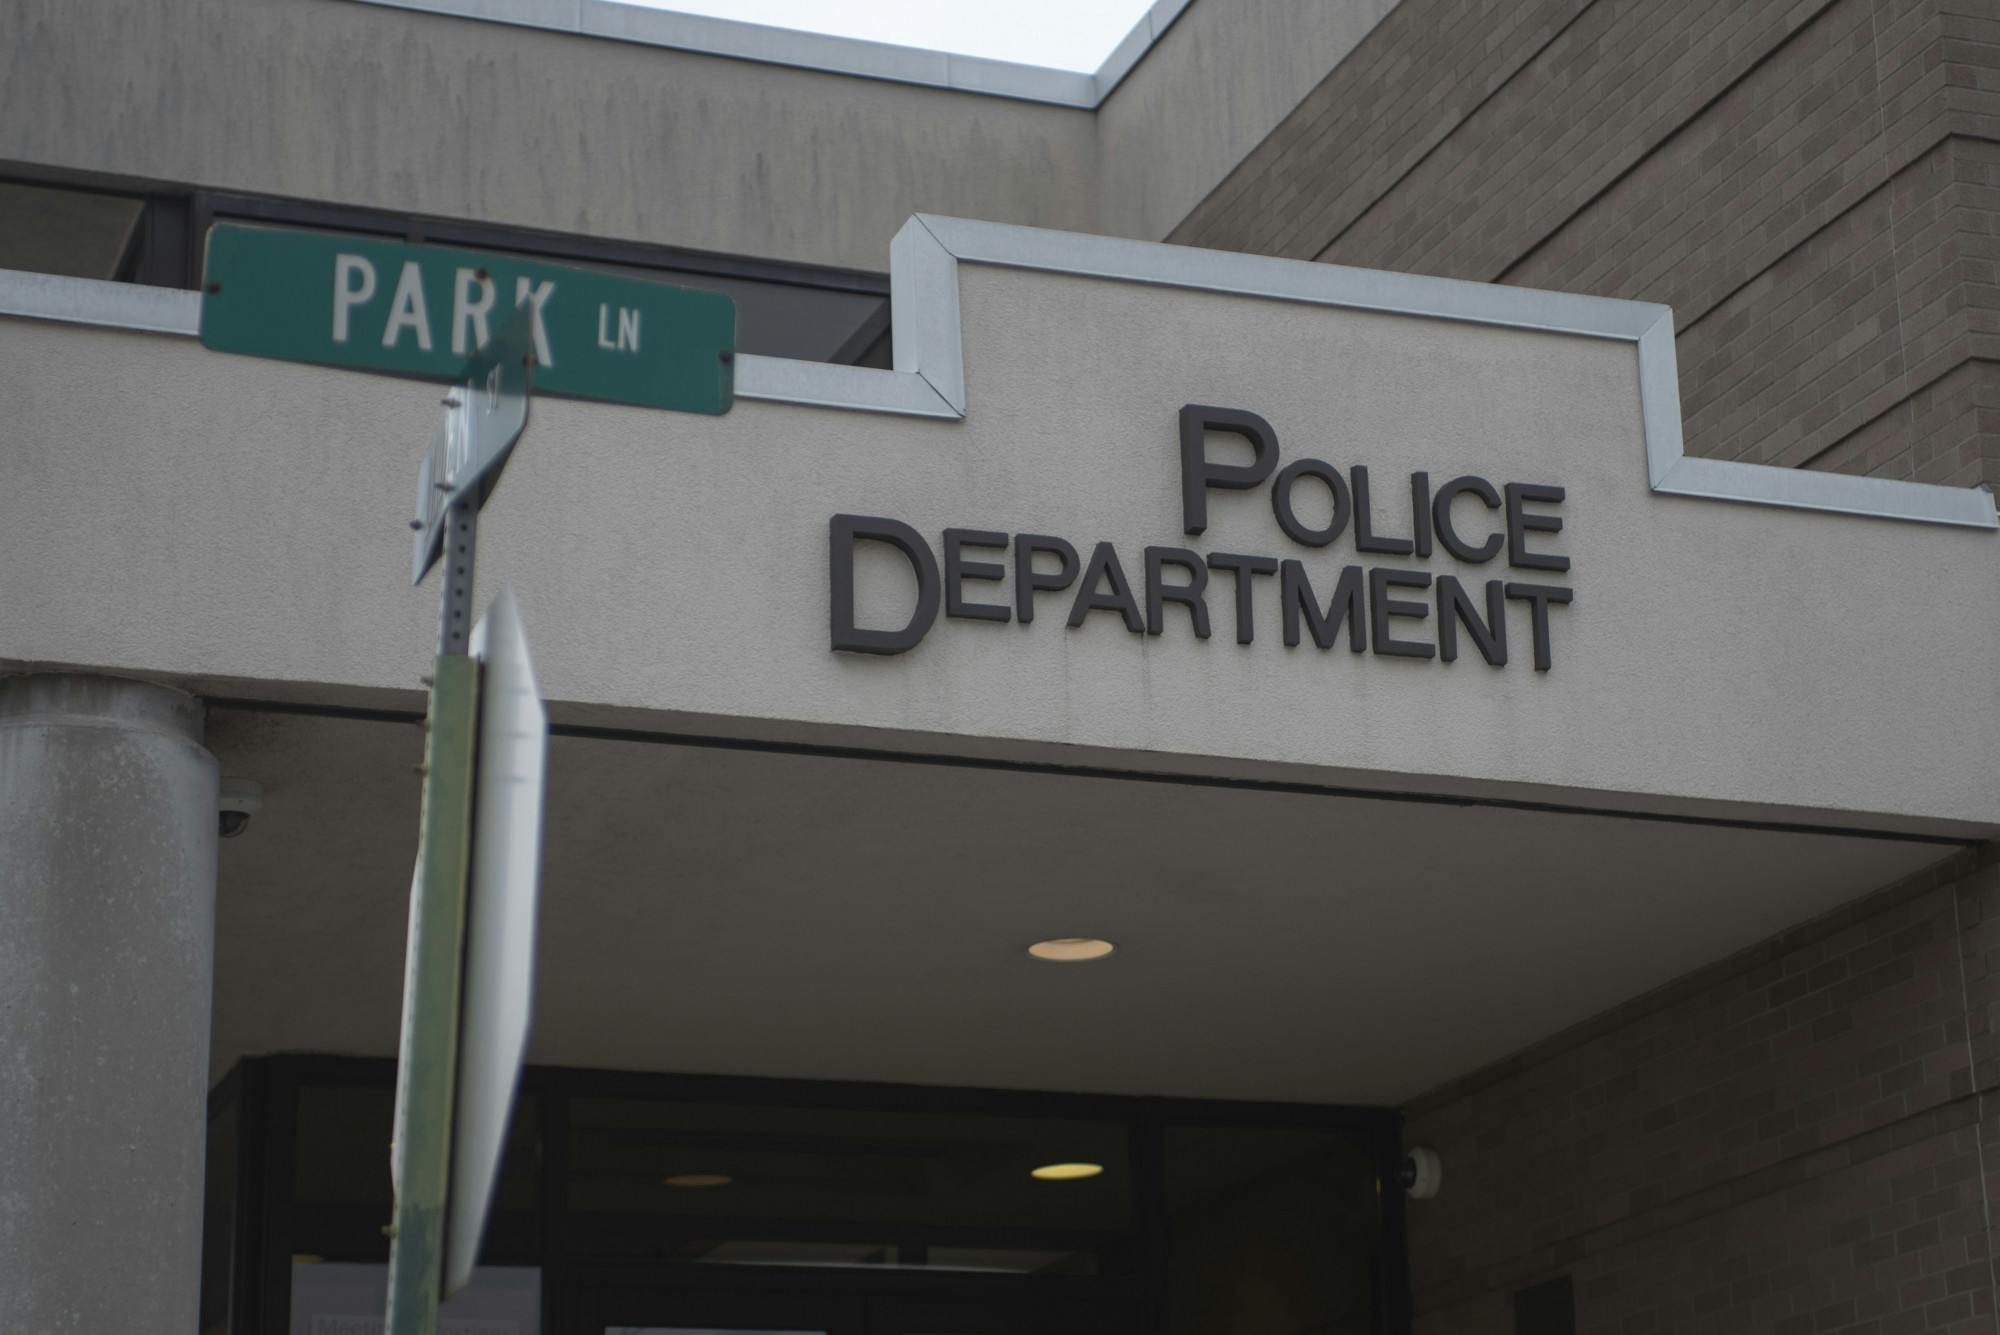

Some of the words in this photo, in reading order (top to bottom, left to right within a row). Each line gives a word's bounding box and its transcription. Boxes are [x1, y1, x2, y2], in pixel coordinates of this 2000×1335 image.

[332, 253, 556, 368] PARK
[597, 303, 641, 353] LN
[1179, 404, 1571, 573] POLICE
[829, 514, 1574, 673] DEPARTMENT
